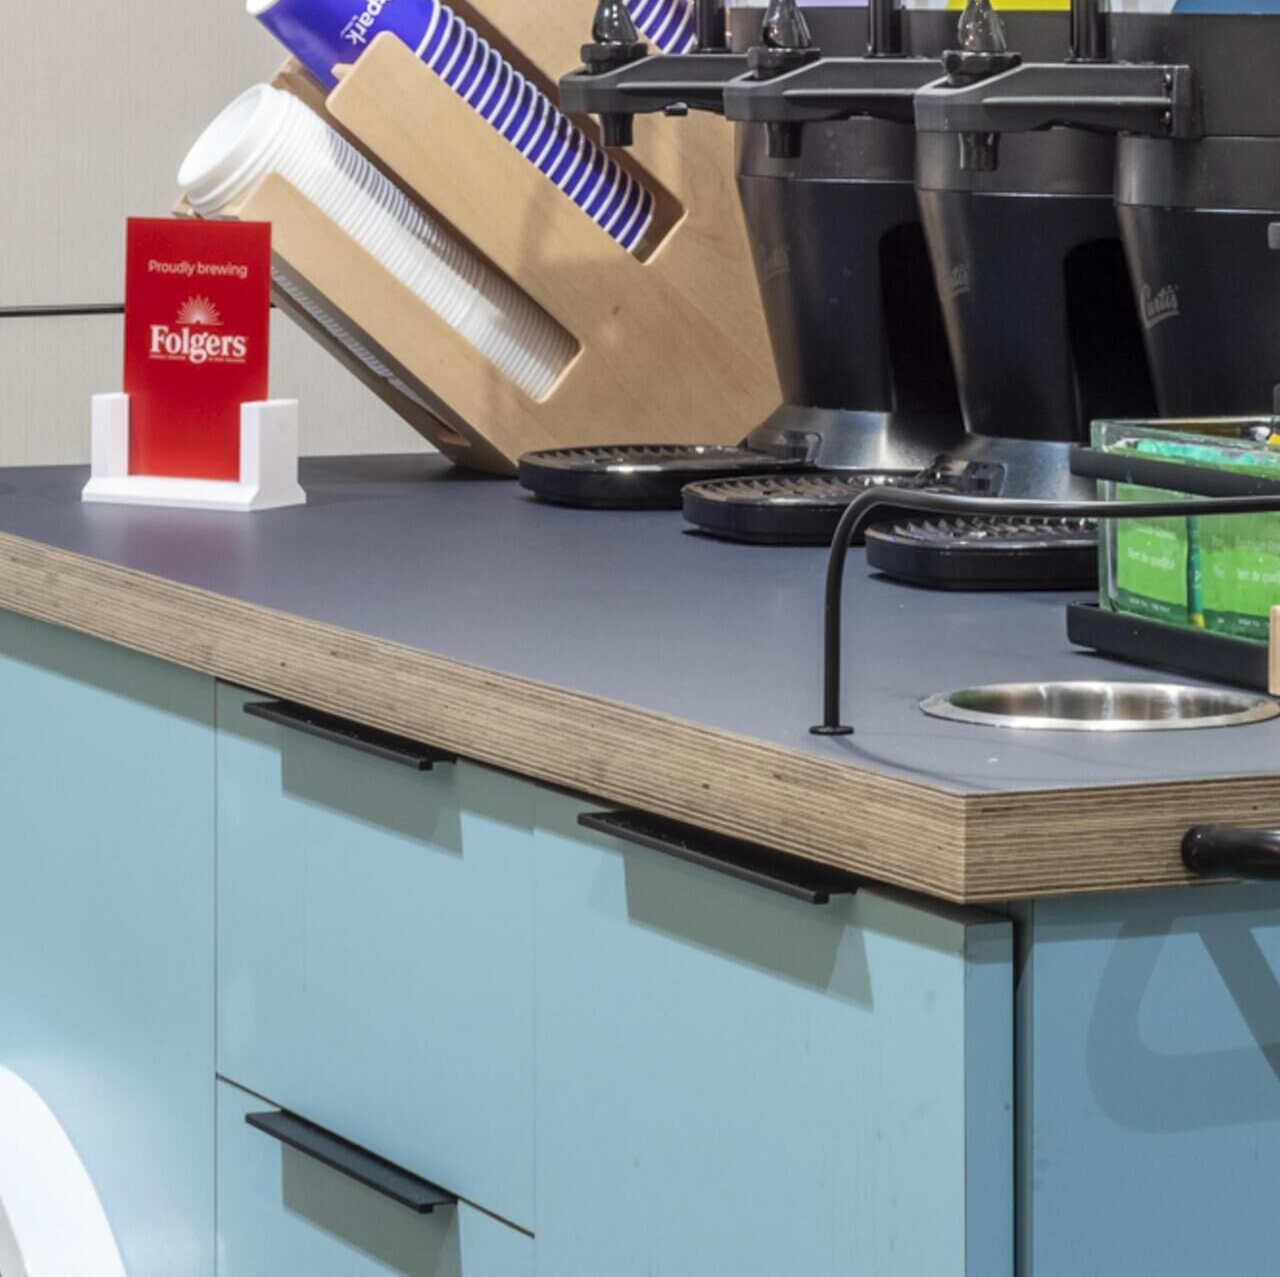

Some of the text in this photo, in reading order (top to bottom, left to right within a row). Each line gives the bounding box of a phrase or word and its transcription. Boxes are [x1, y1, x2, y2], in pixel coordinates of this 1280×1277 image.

[147, 258, 248, 280] Proudly brewing
[1140, 282, 1180, 328] Curtis
[149, 323, 248, 365] Folgers
